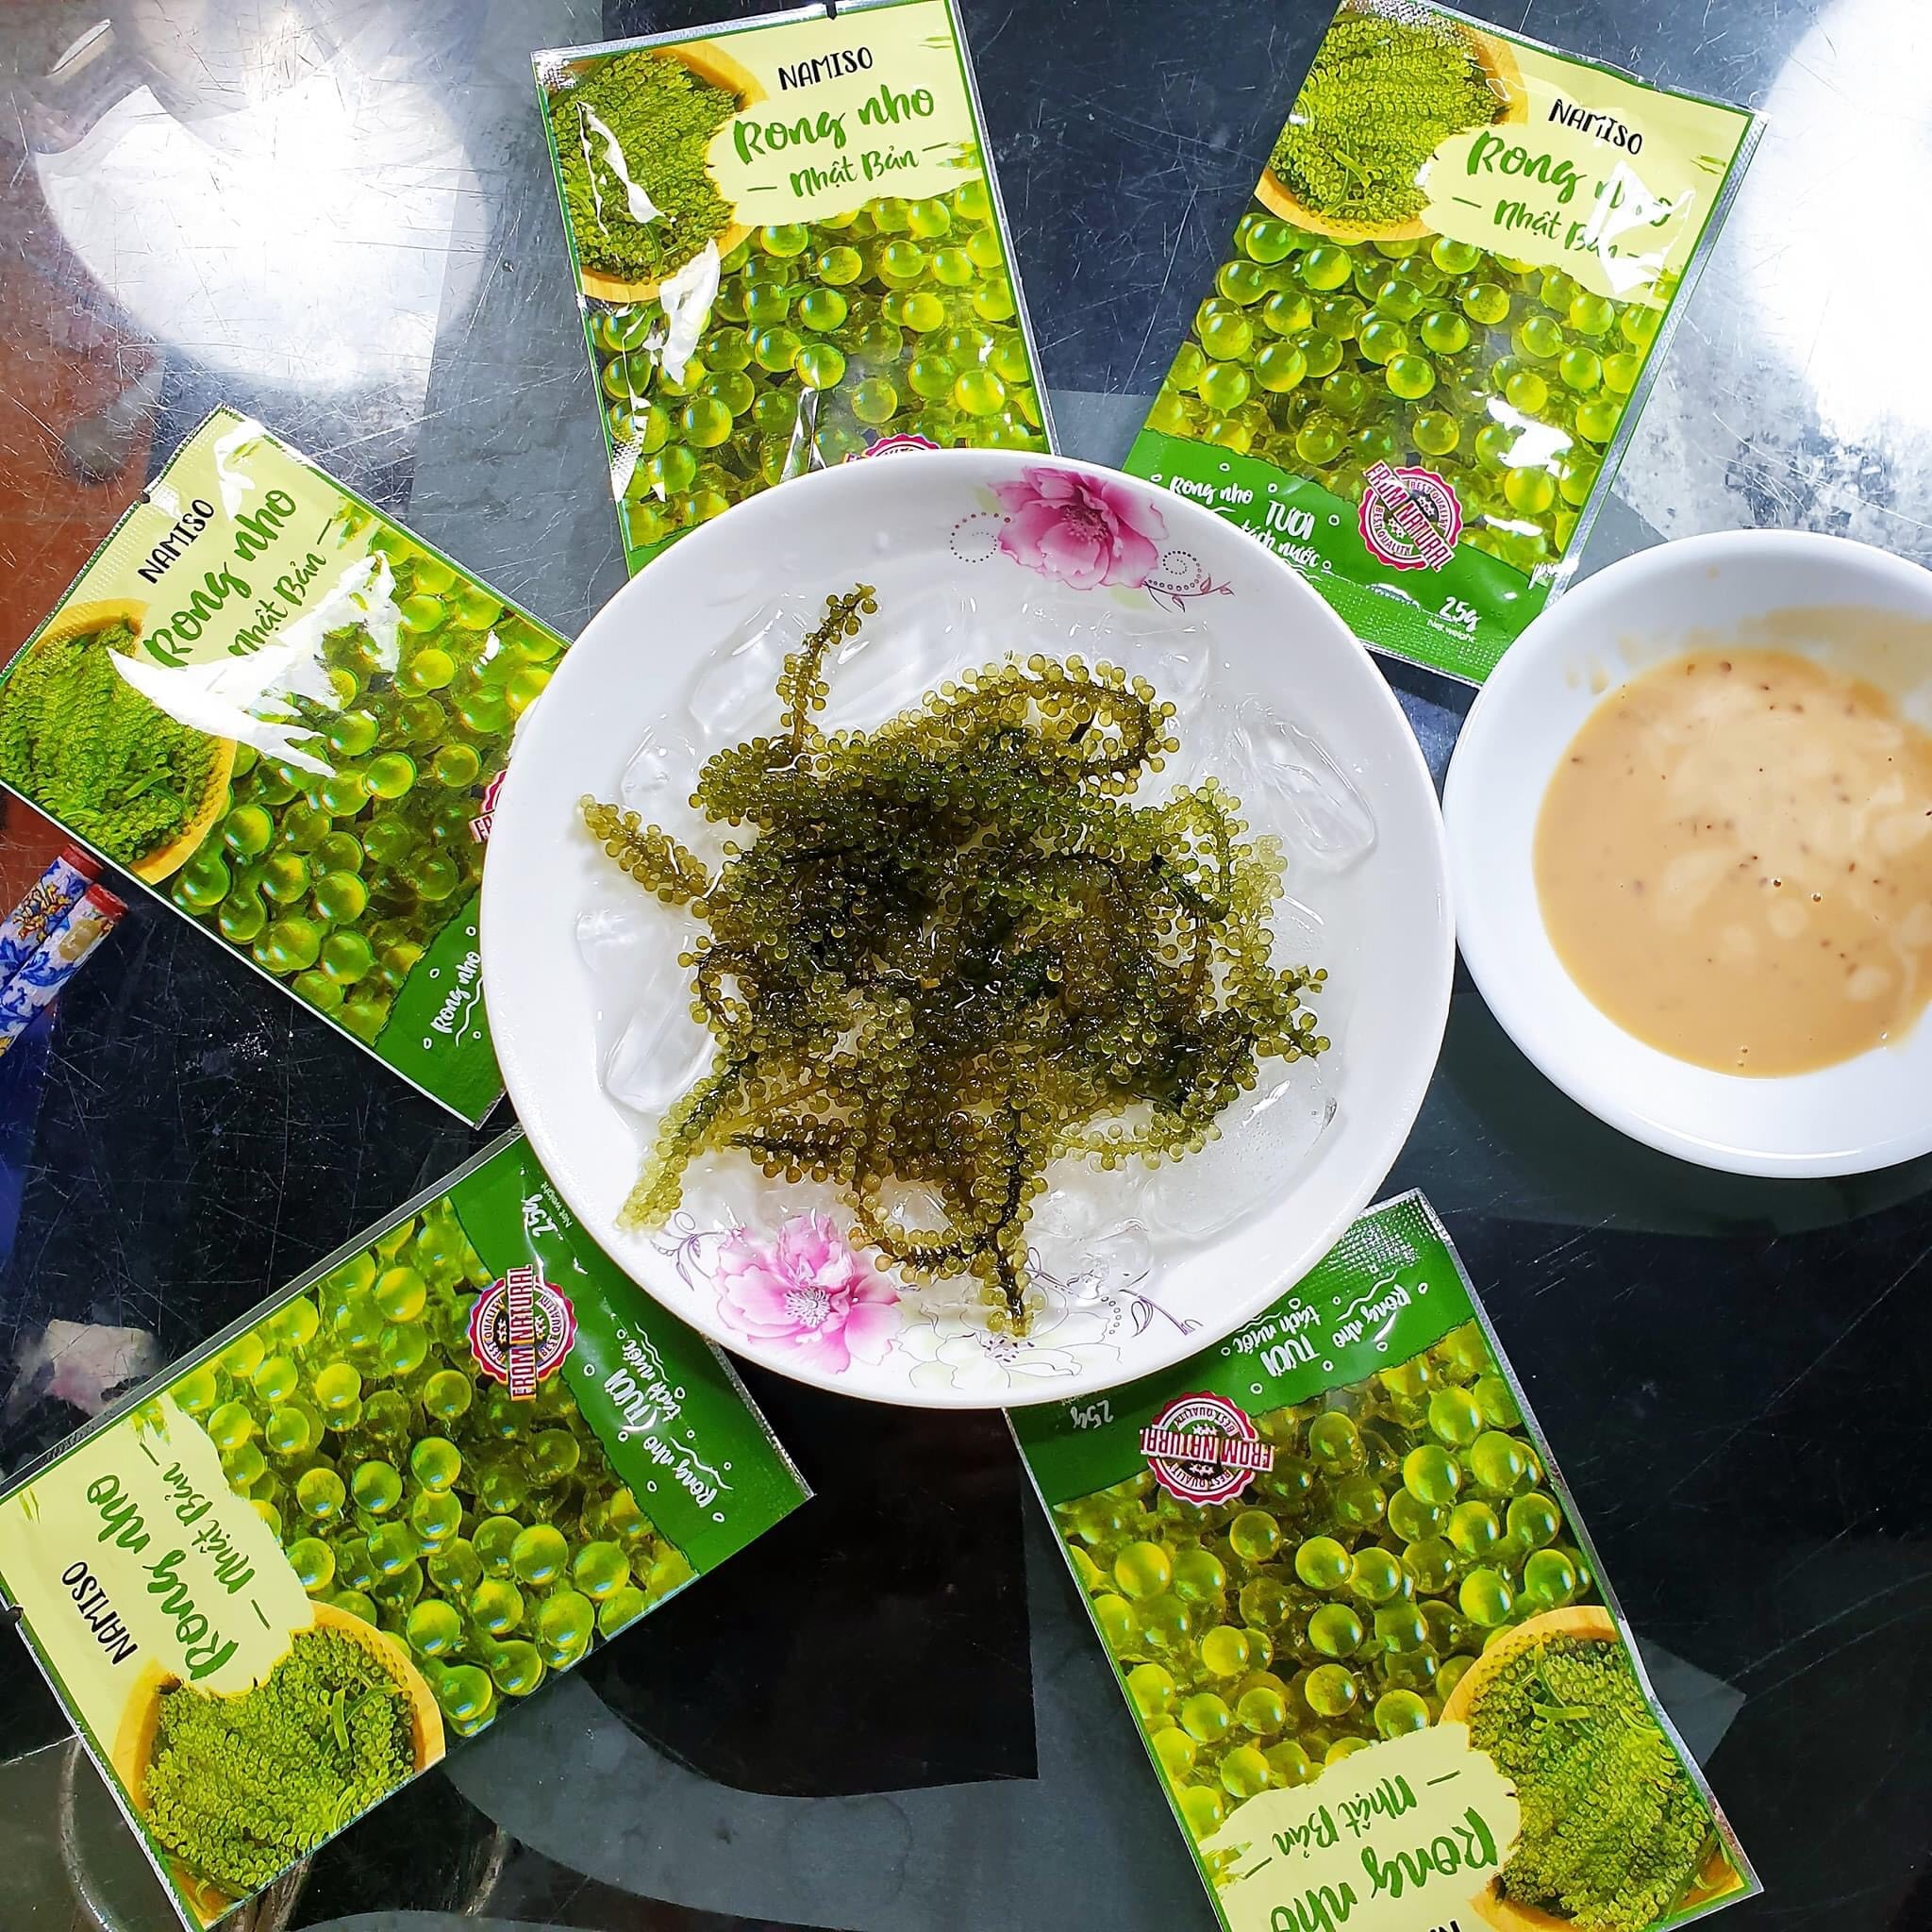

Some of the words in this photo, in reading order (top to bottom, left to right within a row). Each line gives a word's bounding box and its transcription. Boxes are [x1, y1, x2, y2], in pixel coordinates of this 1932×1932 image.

[778, 47, 873, 91] NAMISO
[734, 111, 846, 165] Rong
[858, 84, 934, 125] nho
[1548, 98, 1642, 155] NAMISO
[790, 156, 858, 197] Nhật
[861, 145, 919, 181] Bản
[1466, 130, 1588, 204] Rong
[1493, 199, 1561, 240] Nhật
[1169, 475, 1218, 505] Rong
[1220, 483, 1254, 505] nho
[138, 499, 214, 584] NAMISO
[1394, 502, 1454, 572] NATURAL
[142, 561, 252, 668] Rong
[234, 490, 296, 561] nho
[274, 553, 326, 606] Bản
[1439, 596, 1482, 632] 25g
[430, 985, 471, 1033] Rong
[456, 952, 480, 984] nho
[521, 1194, 558, 1237] 25g
[510, 1264, 533, 1344] NATURAL
[1359, 1283, 1411, 1324] Rong
[540, 1335, 558, 1357] BEST
[1332, 1320, 1364, 1348] nho
[512, 1348, 536, 1397] FROM
[1070, 1399, 1114, 1429] 25g
[1214, 1409, 1237, 1433] BEST
[643, 1436, 675, 1465] nho
[1221, 1440, 1272, 1469] FROM
[163, 1462, 213, 1526] Bản
[673, 1458, 717, 1508] Rong
[87, 1474, 151, 1554] nho
[192, 1519, 255, 1594] Nhật
[62, 1561, 138, 1665] NAMISO
[142, 1549, 239, 1680] Rong
[1273, 1805, 1340, 1859] Bản
[1338, 1774, 1417, 1838] Nhật
[1360, 1807, 1498, 1898] Rong
